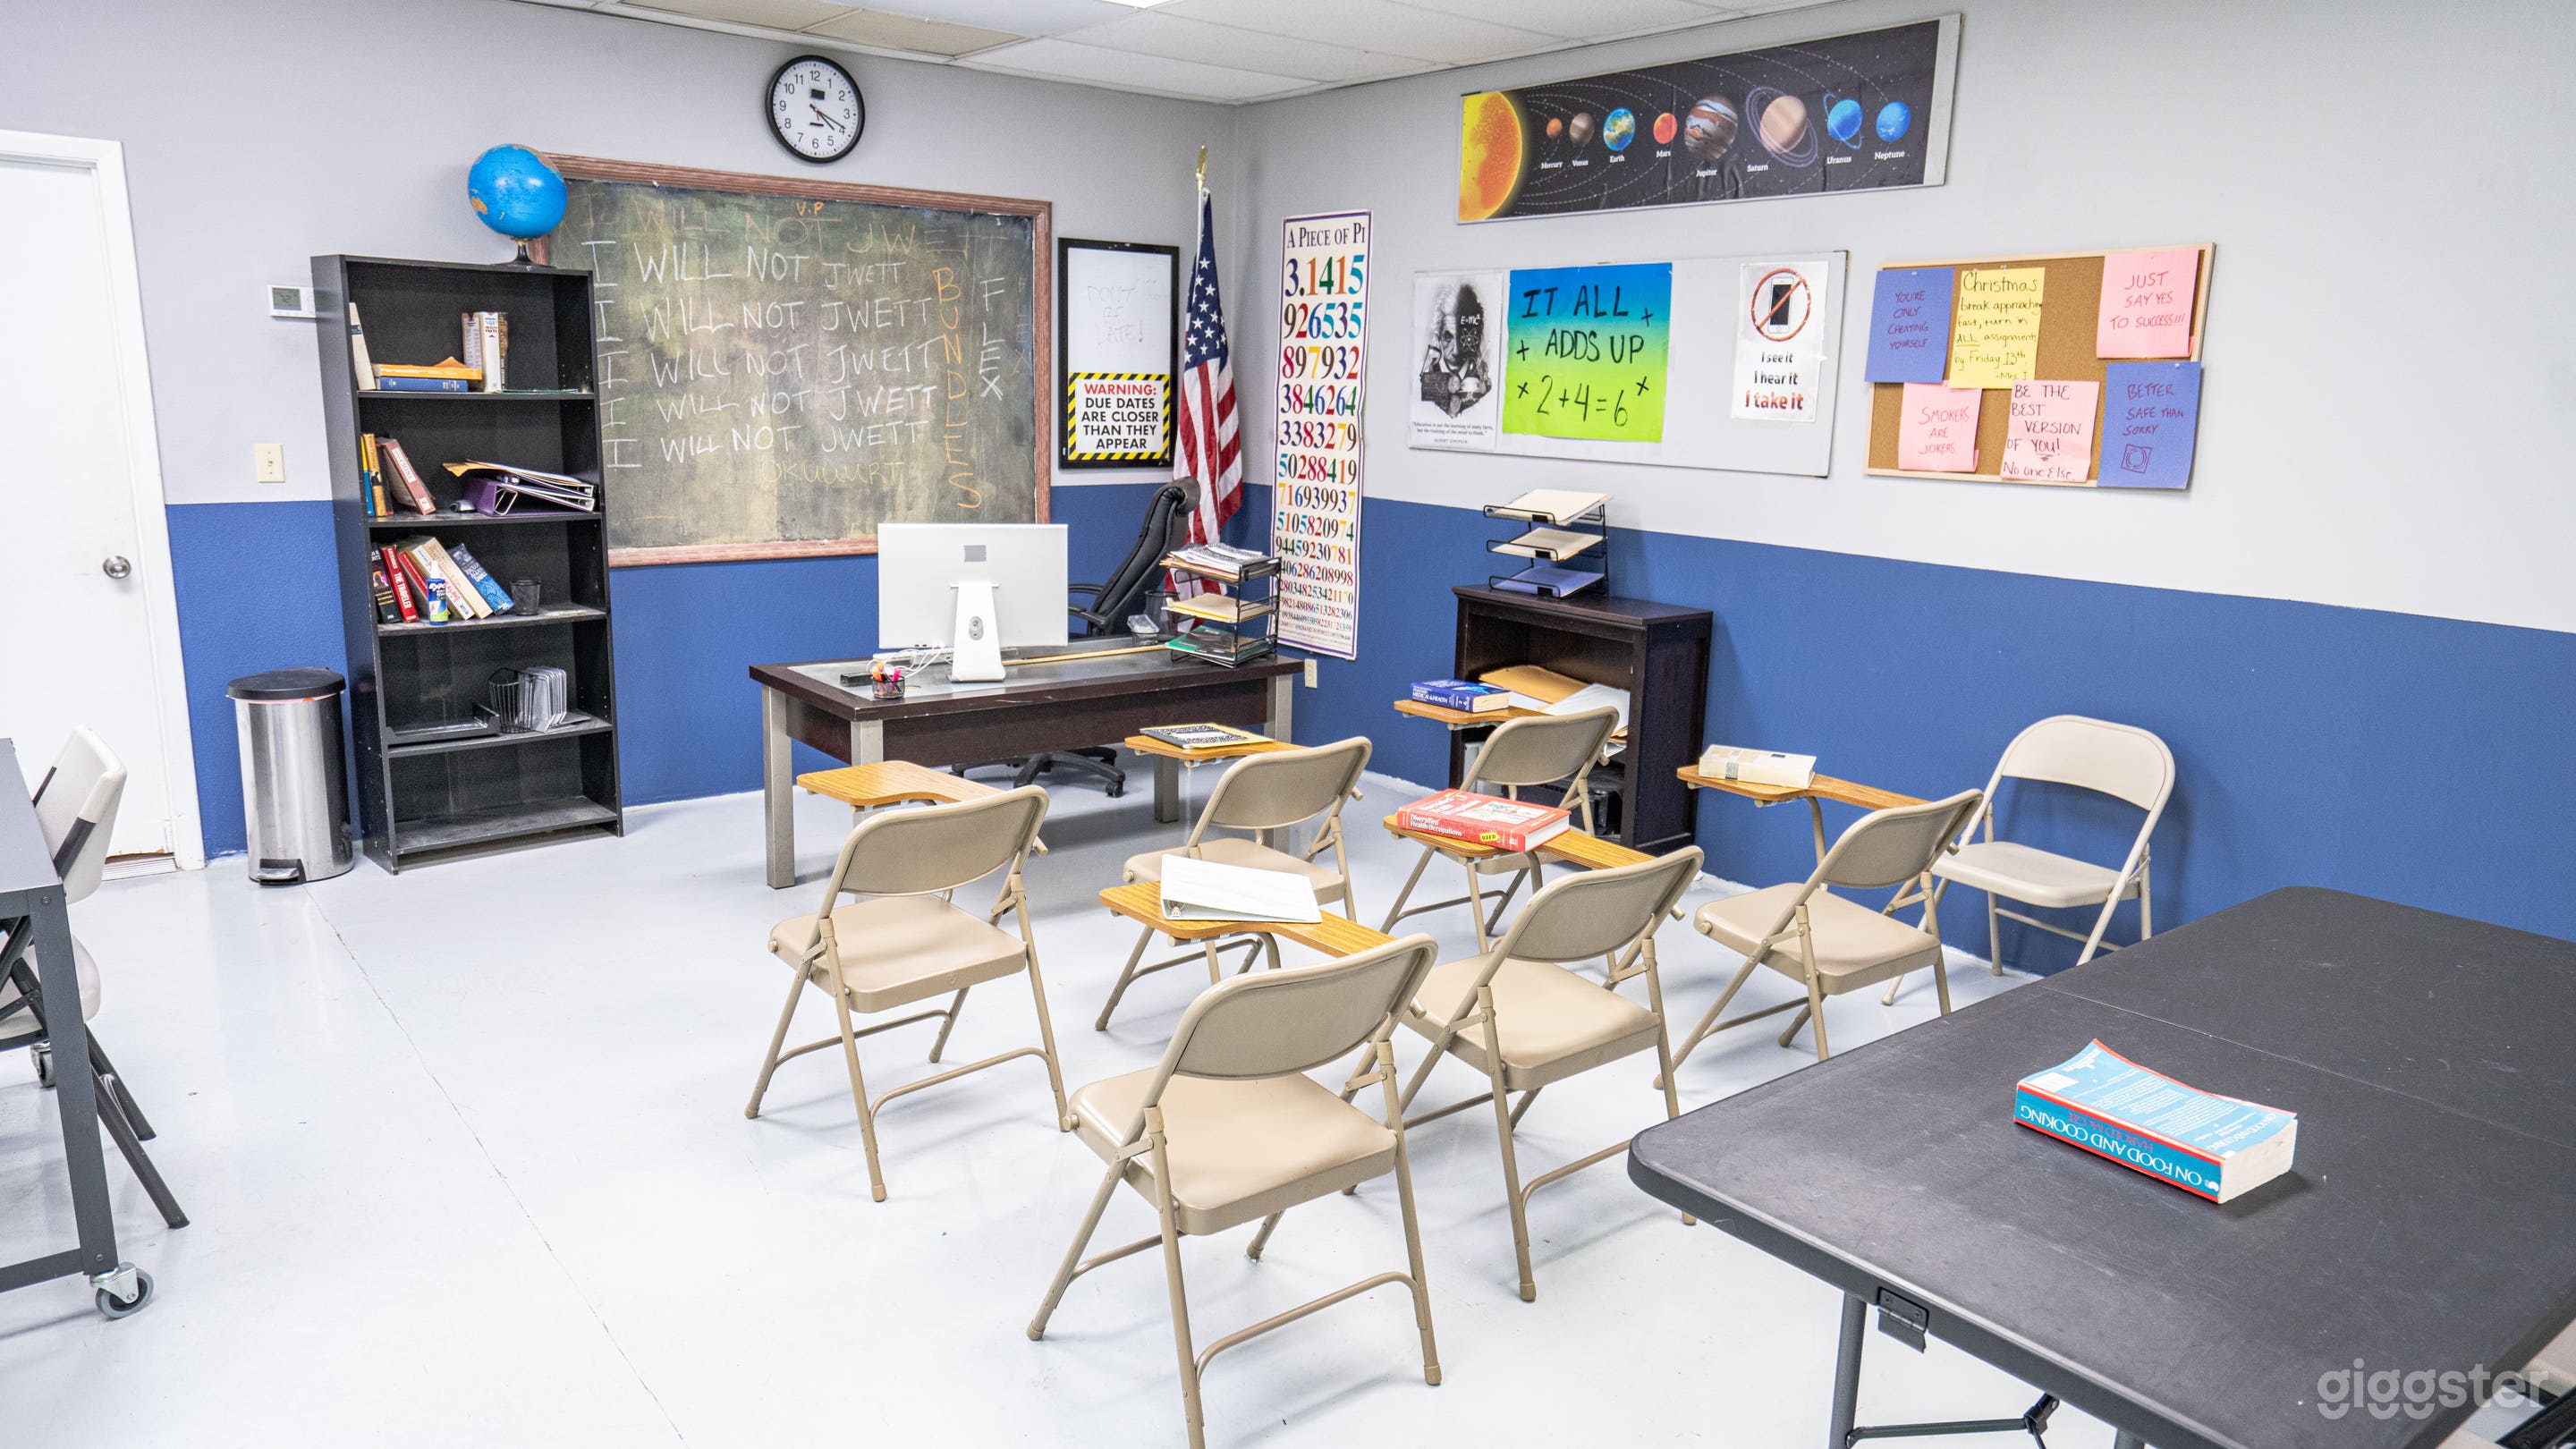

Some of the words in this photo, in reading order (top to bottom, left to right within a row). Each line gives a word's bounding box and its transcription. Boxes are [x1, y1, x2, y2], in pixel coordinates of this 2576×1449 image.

[794, 74, 803, 85] 11
[810, 71, 820, 81] 12
[784, 83, 794, 94] 10
[827, 79, 832, 89] 1
[839, 90, 844, 101] 2
[780, 100, 786, 111] 9
[844, 109, 850, 119] 3
[784, 118, 791, 129] 8
[839, 127, 845, 135] 4
[798, 132, 803, 142] 7
[812, 139, 818, 148] 6
[827, 136, 834, 146] 5
[1610, 155, 1624, 163] Earth
[1657, 150, 1671, 158] Mars
[1826, 156, 1852, 165] Uranus
[1875, 150, 1905, 160] Neptune
[1696, 169, 1717, 178] Jupiter
[1747, 164, 1768, 173] Saturn
[634, 199, 731, 234] WILL
[745, 215, 843, 251] NOT
[1287, 229, 1295, 249] A
[581, 241, 618, 287] I
[633, 241, 733, 284] WILL
[747, 246, 809, 284] NOT
[822, 260, 907, 292] JWETT
[1284, 254, 1366, 297] 3.1415
[1963, 272, 2037, 292] Christmas
[2124, 271, 2169, 290] JUST
[1521, 287, 1559, 318] IT
[1573, 285, 1629, 317] ALL
[1895, 290, 1926, 303] YOU'RE
[1961, 296, 1990, 310] break
[2125, 292, 2155, 308] SAY
[2156, 291, 2174, 305] YES
[595, 299, 623, 342] I
[640, 297, 735, 343] WILL
[743, 301, 807, 331] NOT
[821, 296, 932, 332] JWETT
[1284, 302, 1364, 339] 926535
[1894, 307, 1921, 319] ONLY
[1888, 322, 1929, 335] CHEATING
[1958, 315, 1982, 329] fast,
[2110, 316, 2129, 330] TO
[979, 277, 1006, 402] FLEX
[1889, 338, 1928, 350] YOURSELF
[1956, 334, 1979, 343] ALL
[1545, 329, 1600, 362] ADDS
[1610, 335, 1644, 364] UP
[597, 351, 629, 389] I
[650, 350, 730, 388] WILL
[746, 343, 809, 379] NOT
[826, 335, 945, 384] JWETT
[1282, 345, 1360, 379] 897932
[1767, 353, 1783, 363] see
[1785, 352, 1793, 363] it
[1954, 351, 1964, 371] by
[1970, 351, 2001, 369] Friday
[1760, 371, 1786, 385] hear
[1789, 371, 1798, 386] it
[932, 267, 982, 509] BUNDLES
[1084, 384, 1157, 396] WARNING:
[2014, 384, 2030, 400] BE
[2042, 385, 2071, 401] THE
[2127, 384, 2174, 400] BETTER
[599, 397, 627, 428] I
[657, 392, 741, 423] WILL
[750, 390, 812, 418] NOT
[828, 385, 938, 421] JWETT
[1085, 398, 1111, 409] DUE
[1117, 398, 1155, 409] DATES
[1280, 384, 1358, 417] 3846264
[1746, 390, 1750, 408] I
[1754, 391, 1788, 410] take
[1792, 392, 1804, 411] it
[1081, 411, 1106, 422] ARE
[1112, 411, 1158, 422] CLOSER
[1919, 406, 1970, 426] SMOKERS
[2012, 402, 2046, 417] BEST
[2126, 408, 2156, 420] SAFE
[2161, 408, 2184, 418] THAN
[1083, 425, 1122, 436] THAN
[1126, 425, 1157, 436] THEY
[1929, 427, 1948, 439] ARE
[2025, 420, 2081, 436] VERSION
[2123, 424, 2159, 436] SORRY
[1096, 438, 1147, 449] APPEAR
[1279, 420, 1358, 452] 3383279
[604, 438, 642, 468] I
[660, 436, 724, 464] WILL
[731, 425, 802, 453] NOT
[821, 420, 929, 453] JWETT
[1919, 441, 1955, 455] JOKERS
[2006, 439, 2022, 452] OF
[2031, 437, 2061, 453] YOU!
[1278, 453, 1358, 486] 50288419
[2004, 462, 2020, 475] No
[1278, 482, 1357, 515] 716939937
[1275, 512, 1355, 542] 5105820974
[1275, 536, 1353, 565] 94459230781
[394, 572, 404, 585] THE
[397, 582, 412, 609] TRAVELER
[1411, 821, 1428, 830] Health
[1429, 825, 1463, 837] Occupations
[2021, 1105, 2088, 1141] COOKING
[2091, 1133, 2125, 1156] AND
[2106, 1128, 2153, 1153] HAROLD
[2127, 1148, 2173, 1175] FOOD
[2176, 1166, 2202, 1186] ON
